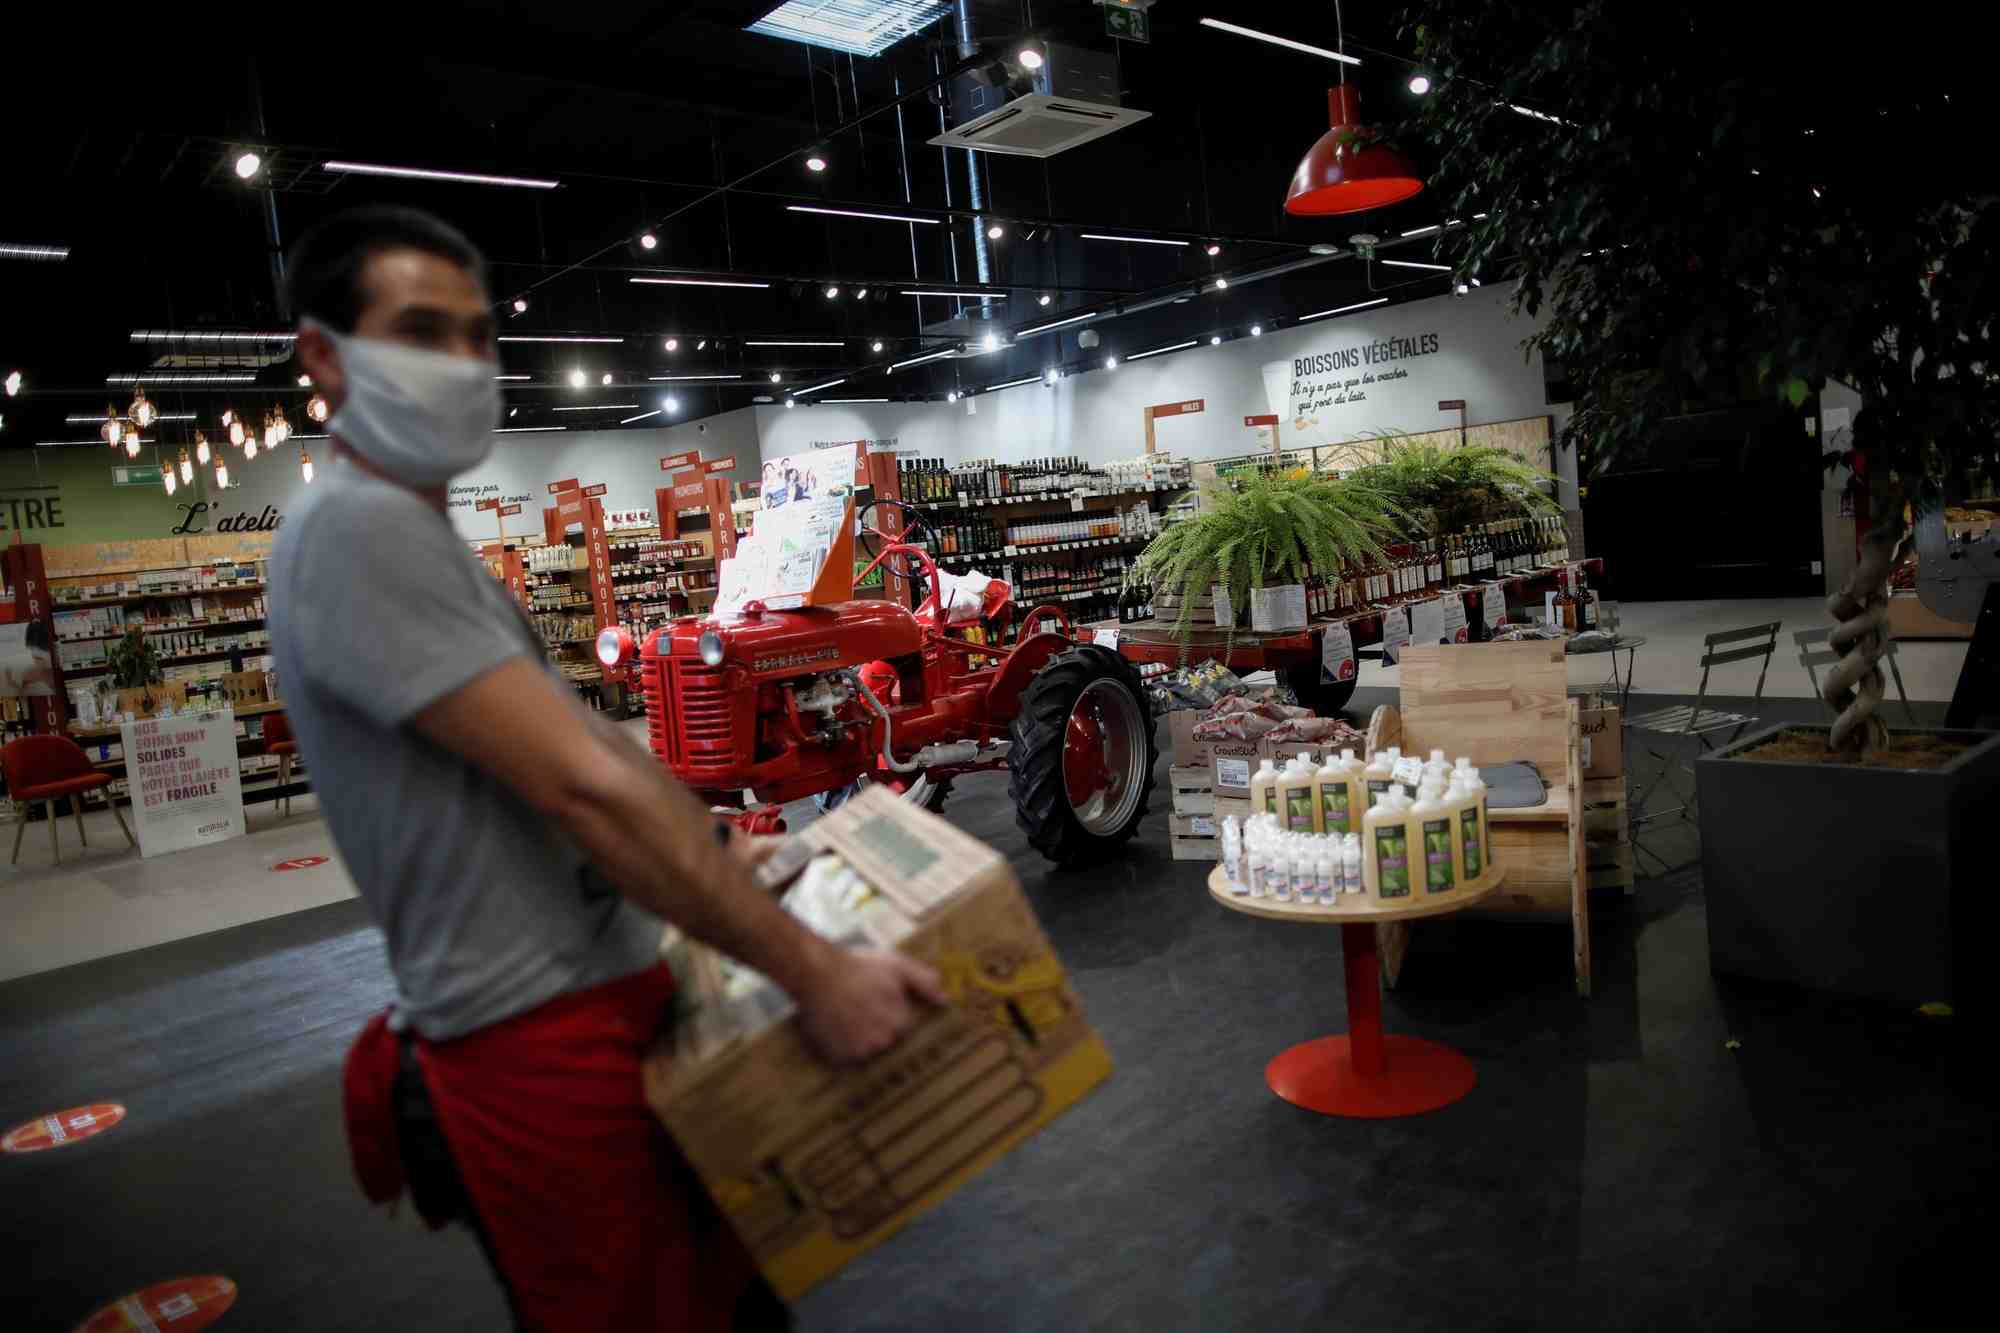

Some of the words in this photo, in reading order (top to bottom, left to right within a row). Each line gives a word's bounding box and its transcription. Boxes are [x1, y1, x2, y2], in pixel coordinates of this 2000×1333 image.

[1294, 348, 1359, 377] BOISSONS
[1362, 333, 1439, 365] VÉGÉTALES
[1325, 382, 1342, 396] pas
[1344, 379, 1360, 393] que
[1362, 373, 1375, 385] les
[1377, 368, 1408, 382] vaches
[1298, 402, 1311, 415] qui
[1334, 394, 1345, 405] du
[137, 746, 186, 764] SOLIDES
[144, 793, 163, 807] EST
[167, 782, 216, 802] FRAGILE
